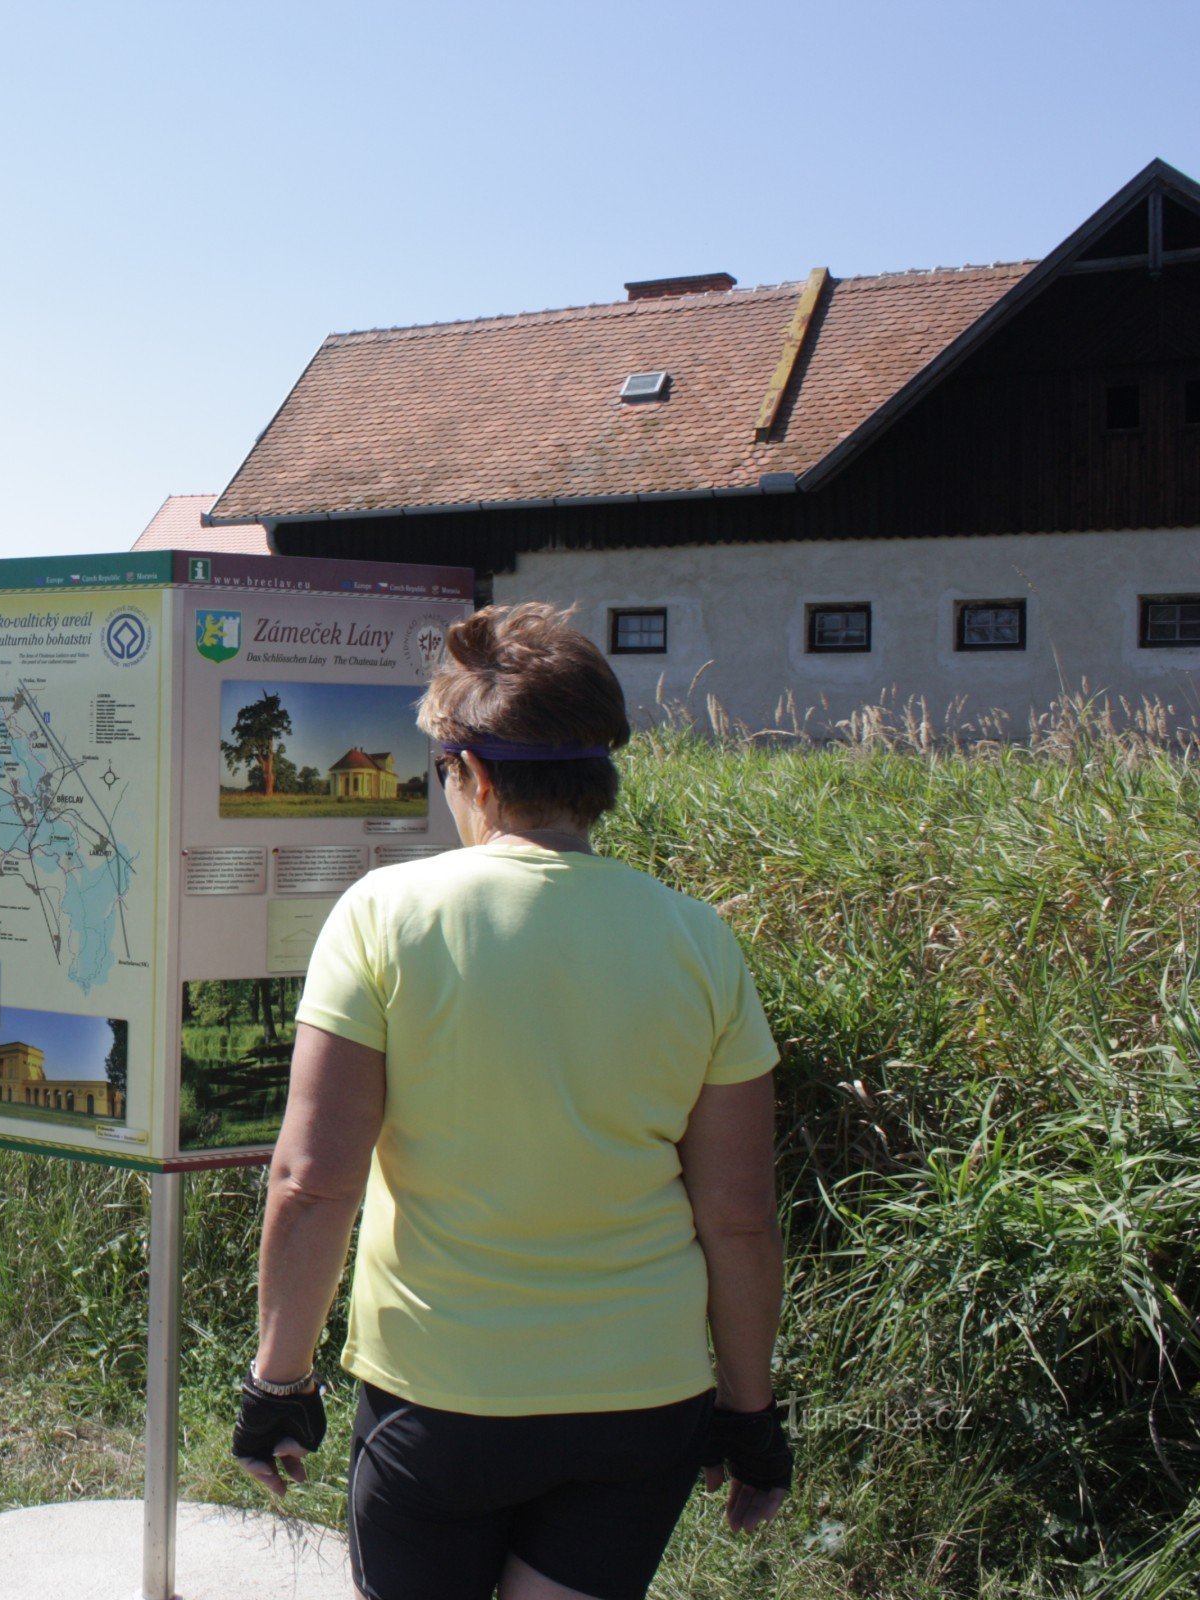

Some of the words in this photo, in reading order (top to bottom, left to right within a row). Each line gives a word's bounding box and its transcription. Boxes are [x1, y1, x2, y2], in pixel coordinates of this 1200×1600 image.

[46, 576, 64, 585] Europe
[82, 574, 98, 583] Czech
[98, 574, 120, 583] Republic
[214, 569, 311, 589] www.breclav.eu
[353, 581, 372, 590] Europe
[389, 583, 405, 592] Czech
[405, 584, 426, 593] Republic
[62, 611, 93, 627] areál
[46, 632, 92, 645] bohatství
[253, 617, 341, 645] Zámeček
[346, 622, 394, 653] Lány
[246, 652, 261, 662] Das
[263, 652, 307, 664] Schlösschen
[309, 654, 327, 666] Lány
[333, 656, 347, 665] The
[349, 656, 378, 666] Chateau
[379, 657, 397, 669] Lány
[56, 794, 83, 804] BŘECLAV
